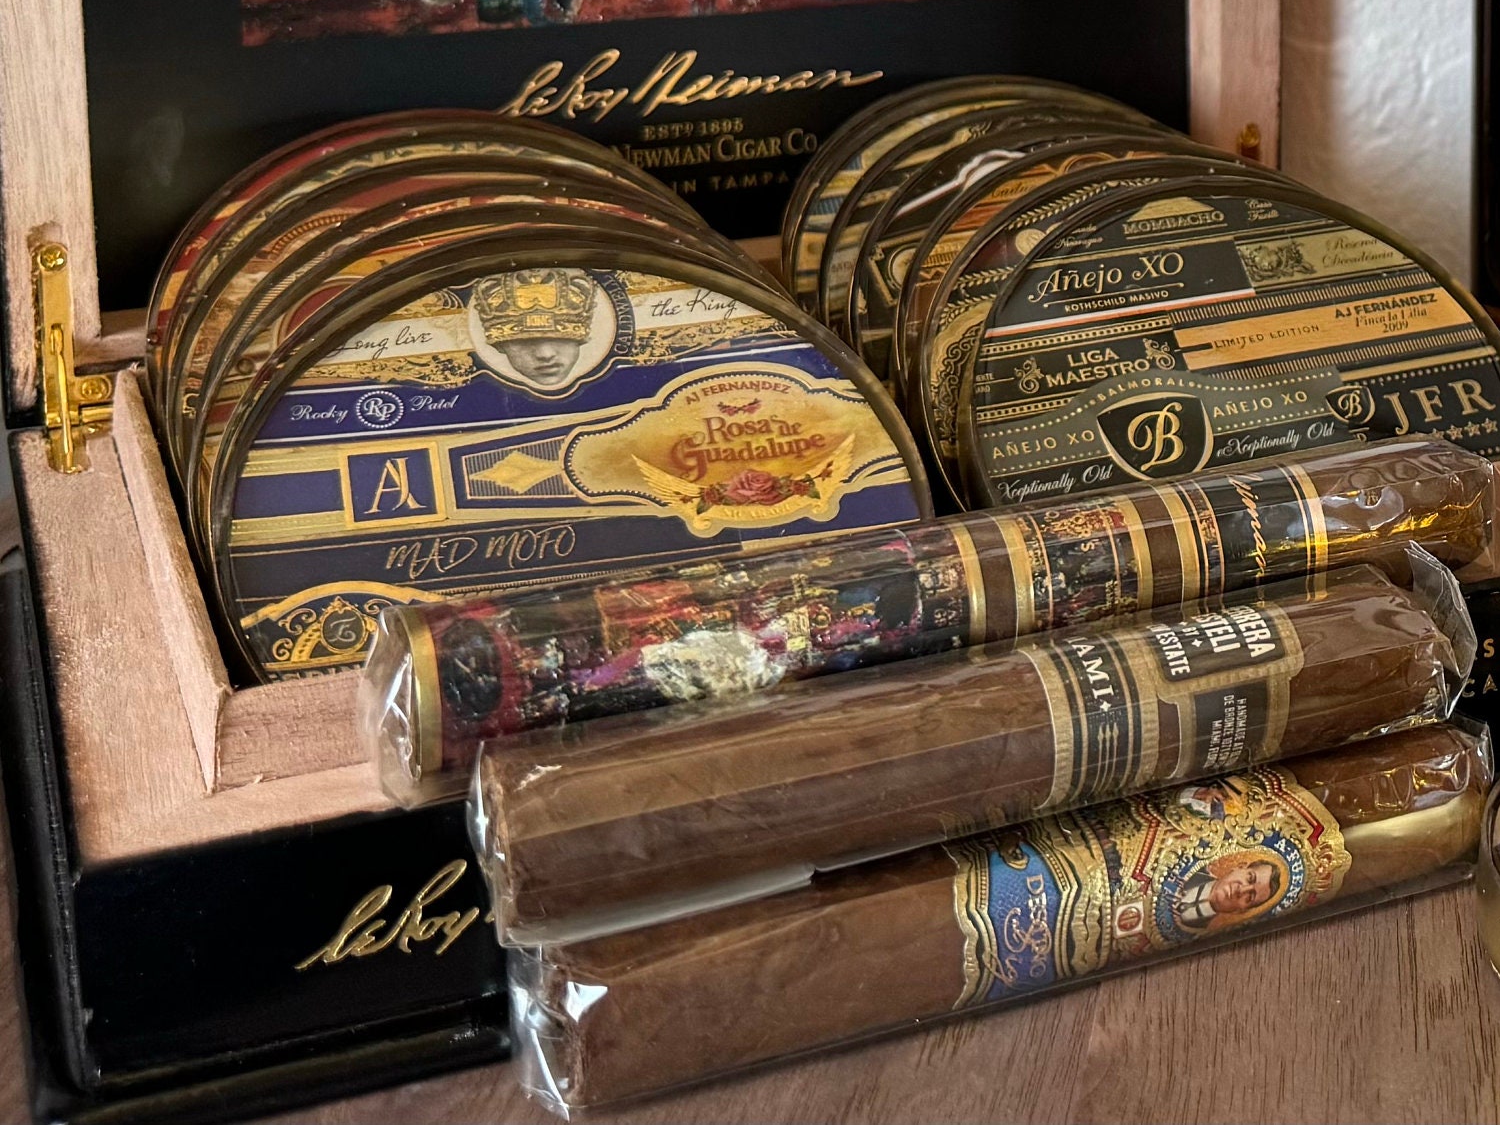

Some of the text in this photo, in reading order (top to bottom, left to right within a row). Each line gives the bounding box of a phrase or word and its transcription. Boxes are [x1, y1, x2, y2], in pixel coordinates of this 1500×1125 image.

[632, 49, 884, 118] Neiman
[712, 171, 790, 191] TAMPA
[1122, 210, 1225, 235] MOMBACHO
[1028, 251, 1184, 303] Añejo XO
[650, 289, 739, 319] the King
[1064, 289, 1169, 313] ROTHSCHILD MASIVO
[1334, 292, 1438, 319] AJ FERNÁNDEZ
[395, 326, 434, 346] live
[1213, 324, 1320, 350] LIMITED EDITION
[1382, 320, 1409, 334] 2009
[1067, 348, 1120, 368] LIGA
[1045, 358, 1151, 388] MAESTRO
[702, 380, 793, 396] FERNANDEZ
[1098, 376, 1185, 402] BALMORAL
[290, 404, 348, 423] Rocky
[410, 395, 461, 413] Patel
[1213, 389, 1308, 418] AÑEJO XO
[1383, 378, 1497, 435] JFR
[702, 416, 773, 445] Rosa
[1307, 421, 1336, 441] Old
[670, 431, 826, 481] Guadalupe
[991, 429, 1096, 460] AÑEJO XO
[1082, 464, 1113, 484] Old
[385, 524, 577, 579] MAD MOFO
[1063, 636, 1115, 700] IAMI
